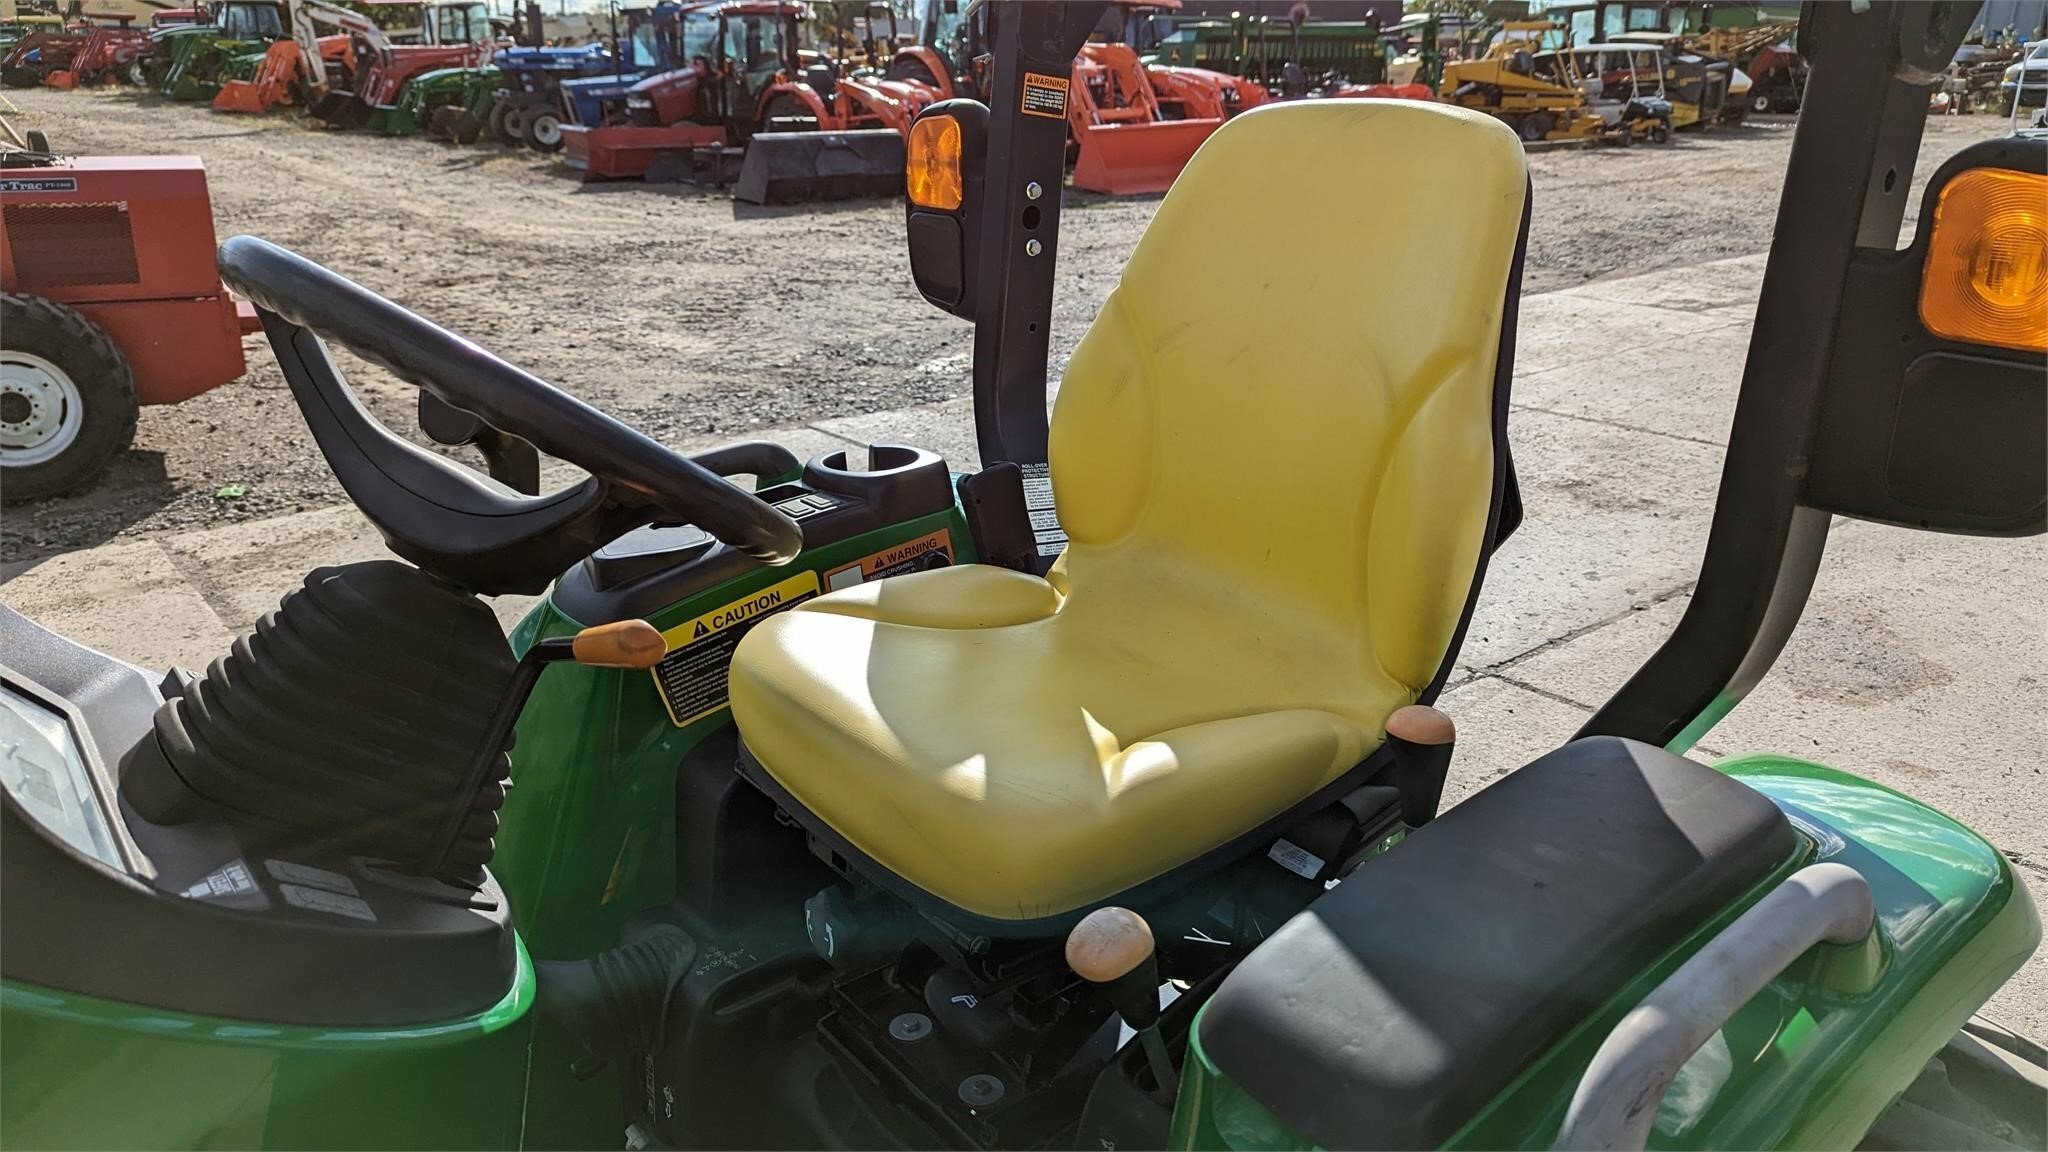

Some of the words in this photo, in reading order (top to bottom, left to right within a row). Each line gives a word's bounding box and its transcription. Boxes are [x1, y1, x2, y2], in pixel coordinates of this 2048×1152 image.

[1033, 75, 1067, 89] WARNING
[9, 181, 42, 190] Trac
[887, 538, 937, 563] WARNING
[712, 591, 782, 629] CAUTION
